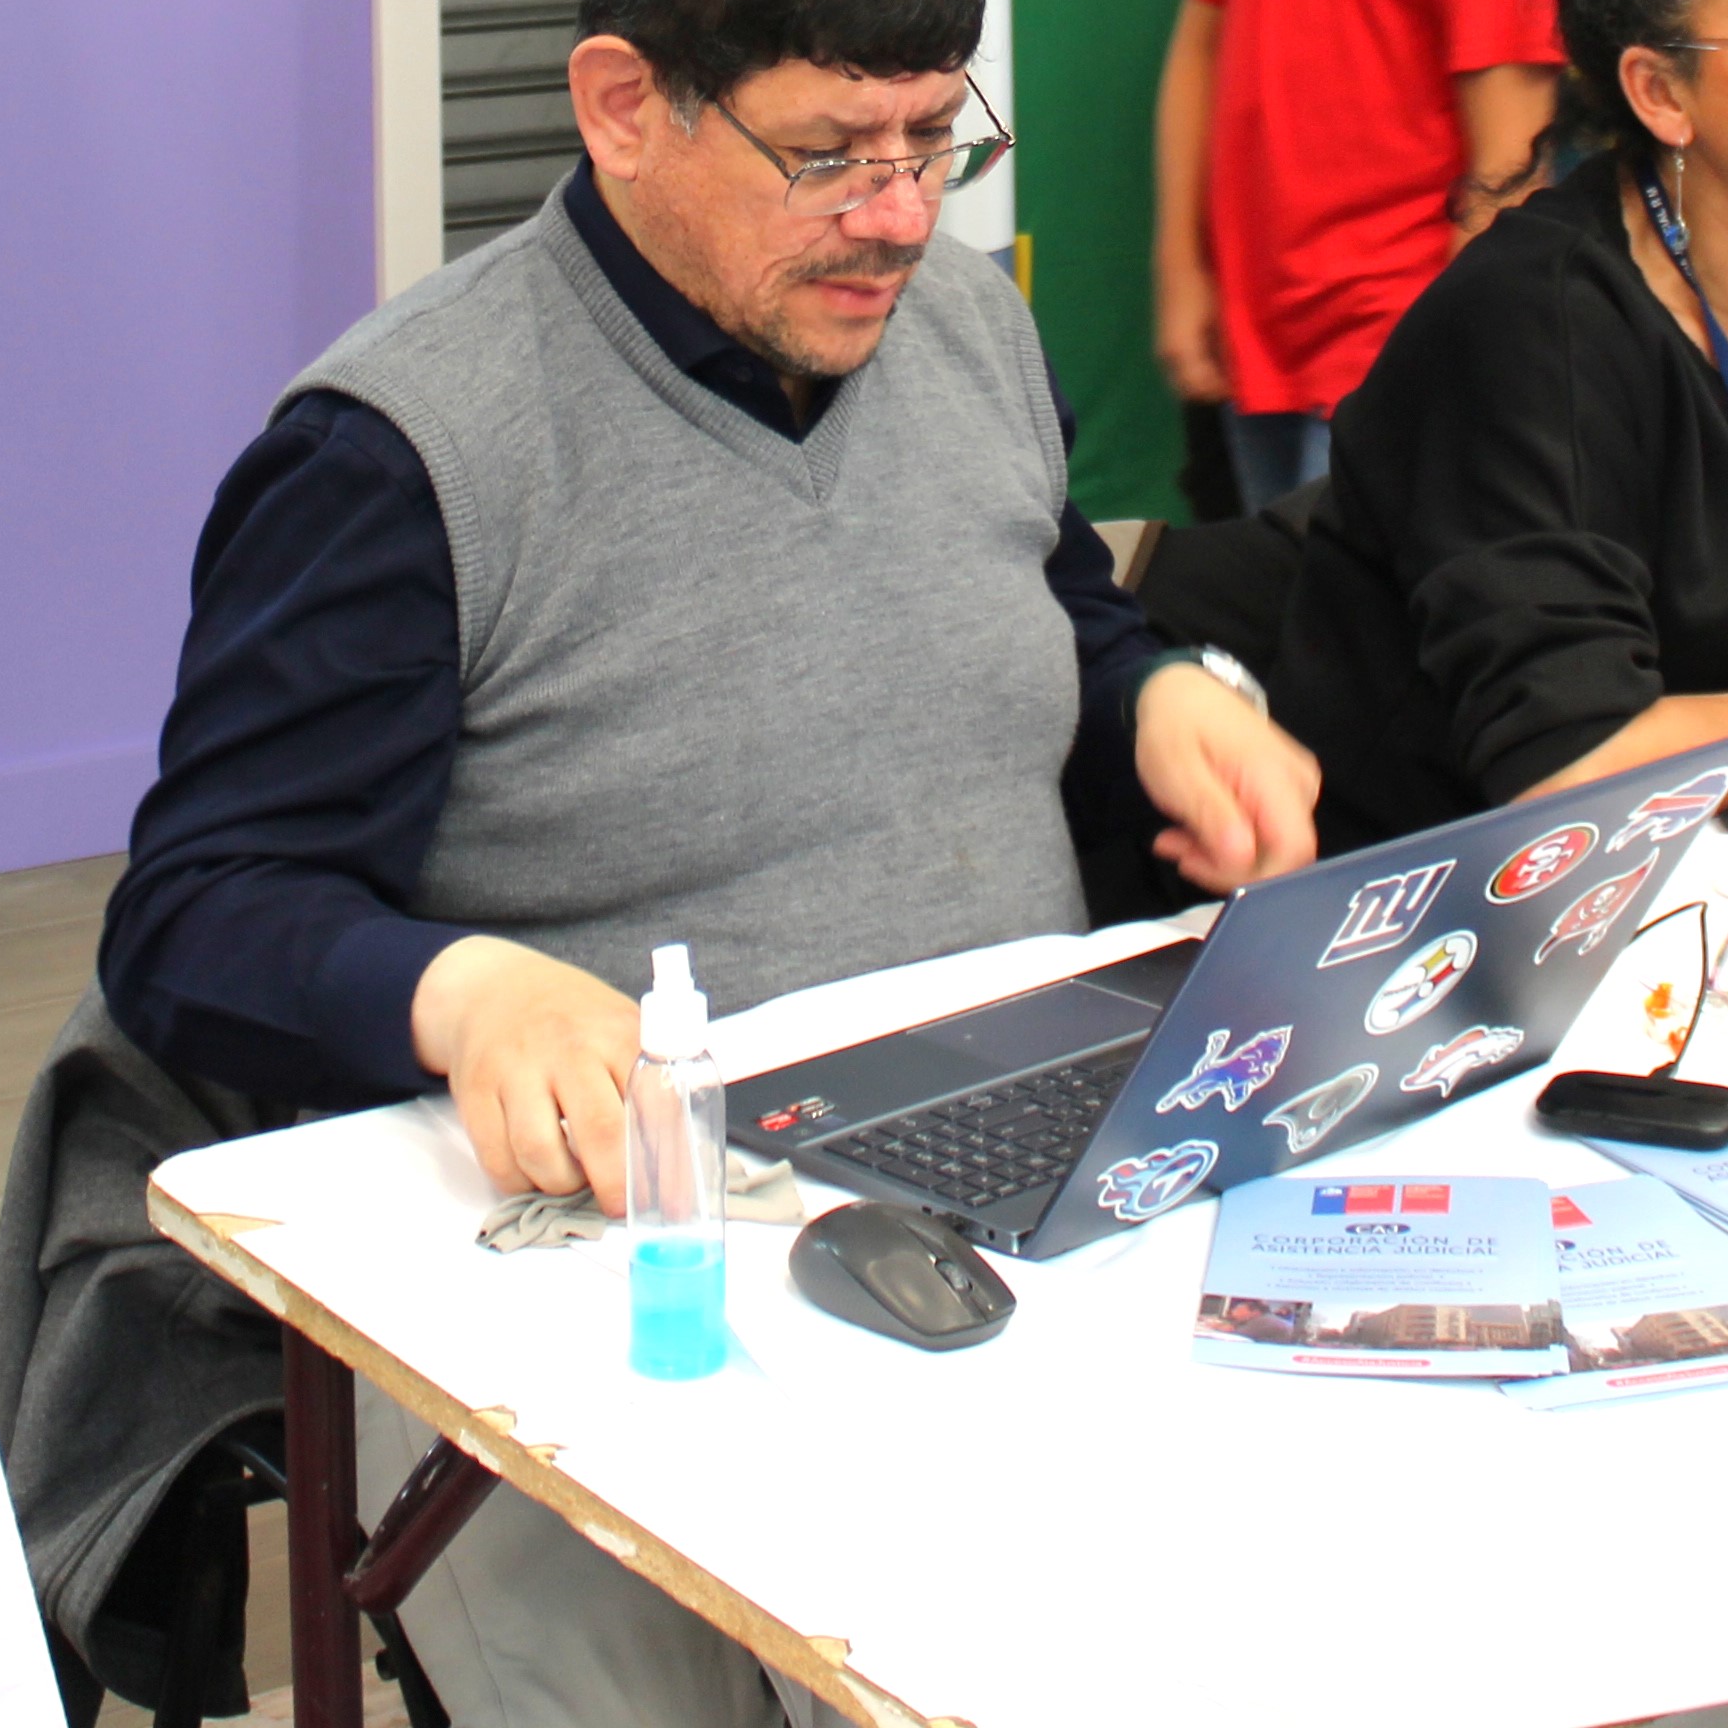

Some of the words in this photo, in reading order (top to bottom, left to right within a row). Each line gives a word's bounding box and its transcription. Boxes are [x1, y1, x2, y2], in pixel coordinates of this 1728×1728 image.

[1355, 1223, 1399, 1235] CAJ
[1253, 1234, 1449, 1246] CORPORACIÓN
[1467, 1236, 1500, 1245] DE
[1251, 1244, 1382, 1255] ASISTENCIA
[1393, 1245, 1499, 1256] JUDICIAL
[1582, 1249, 1681, 1270] JUDICIAL
